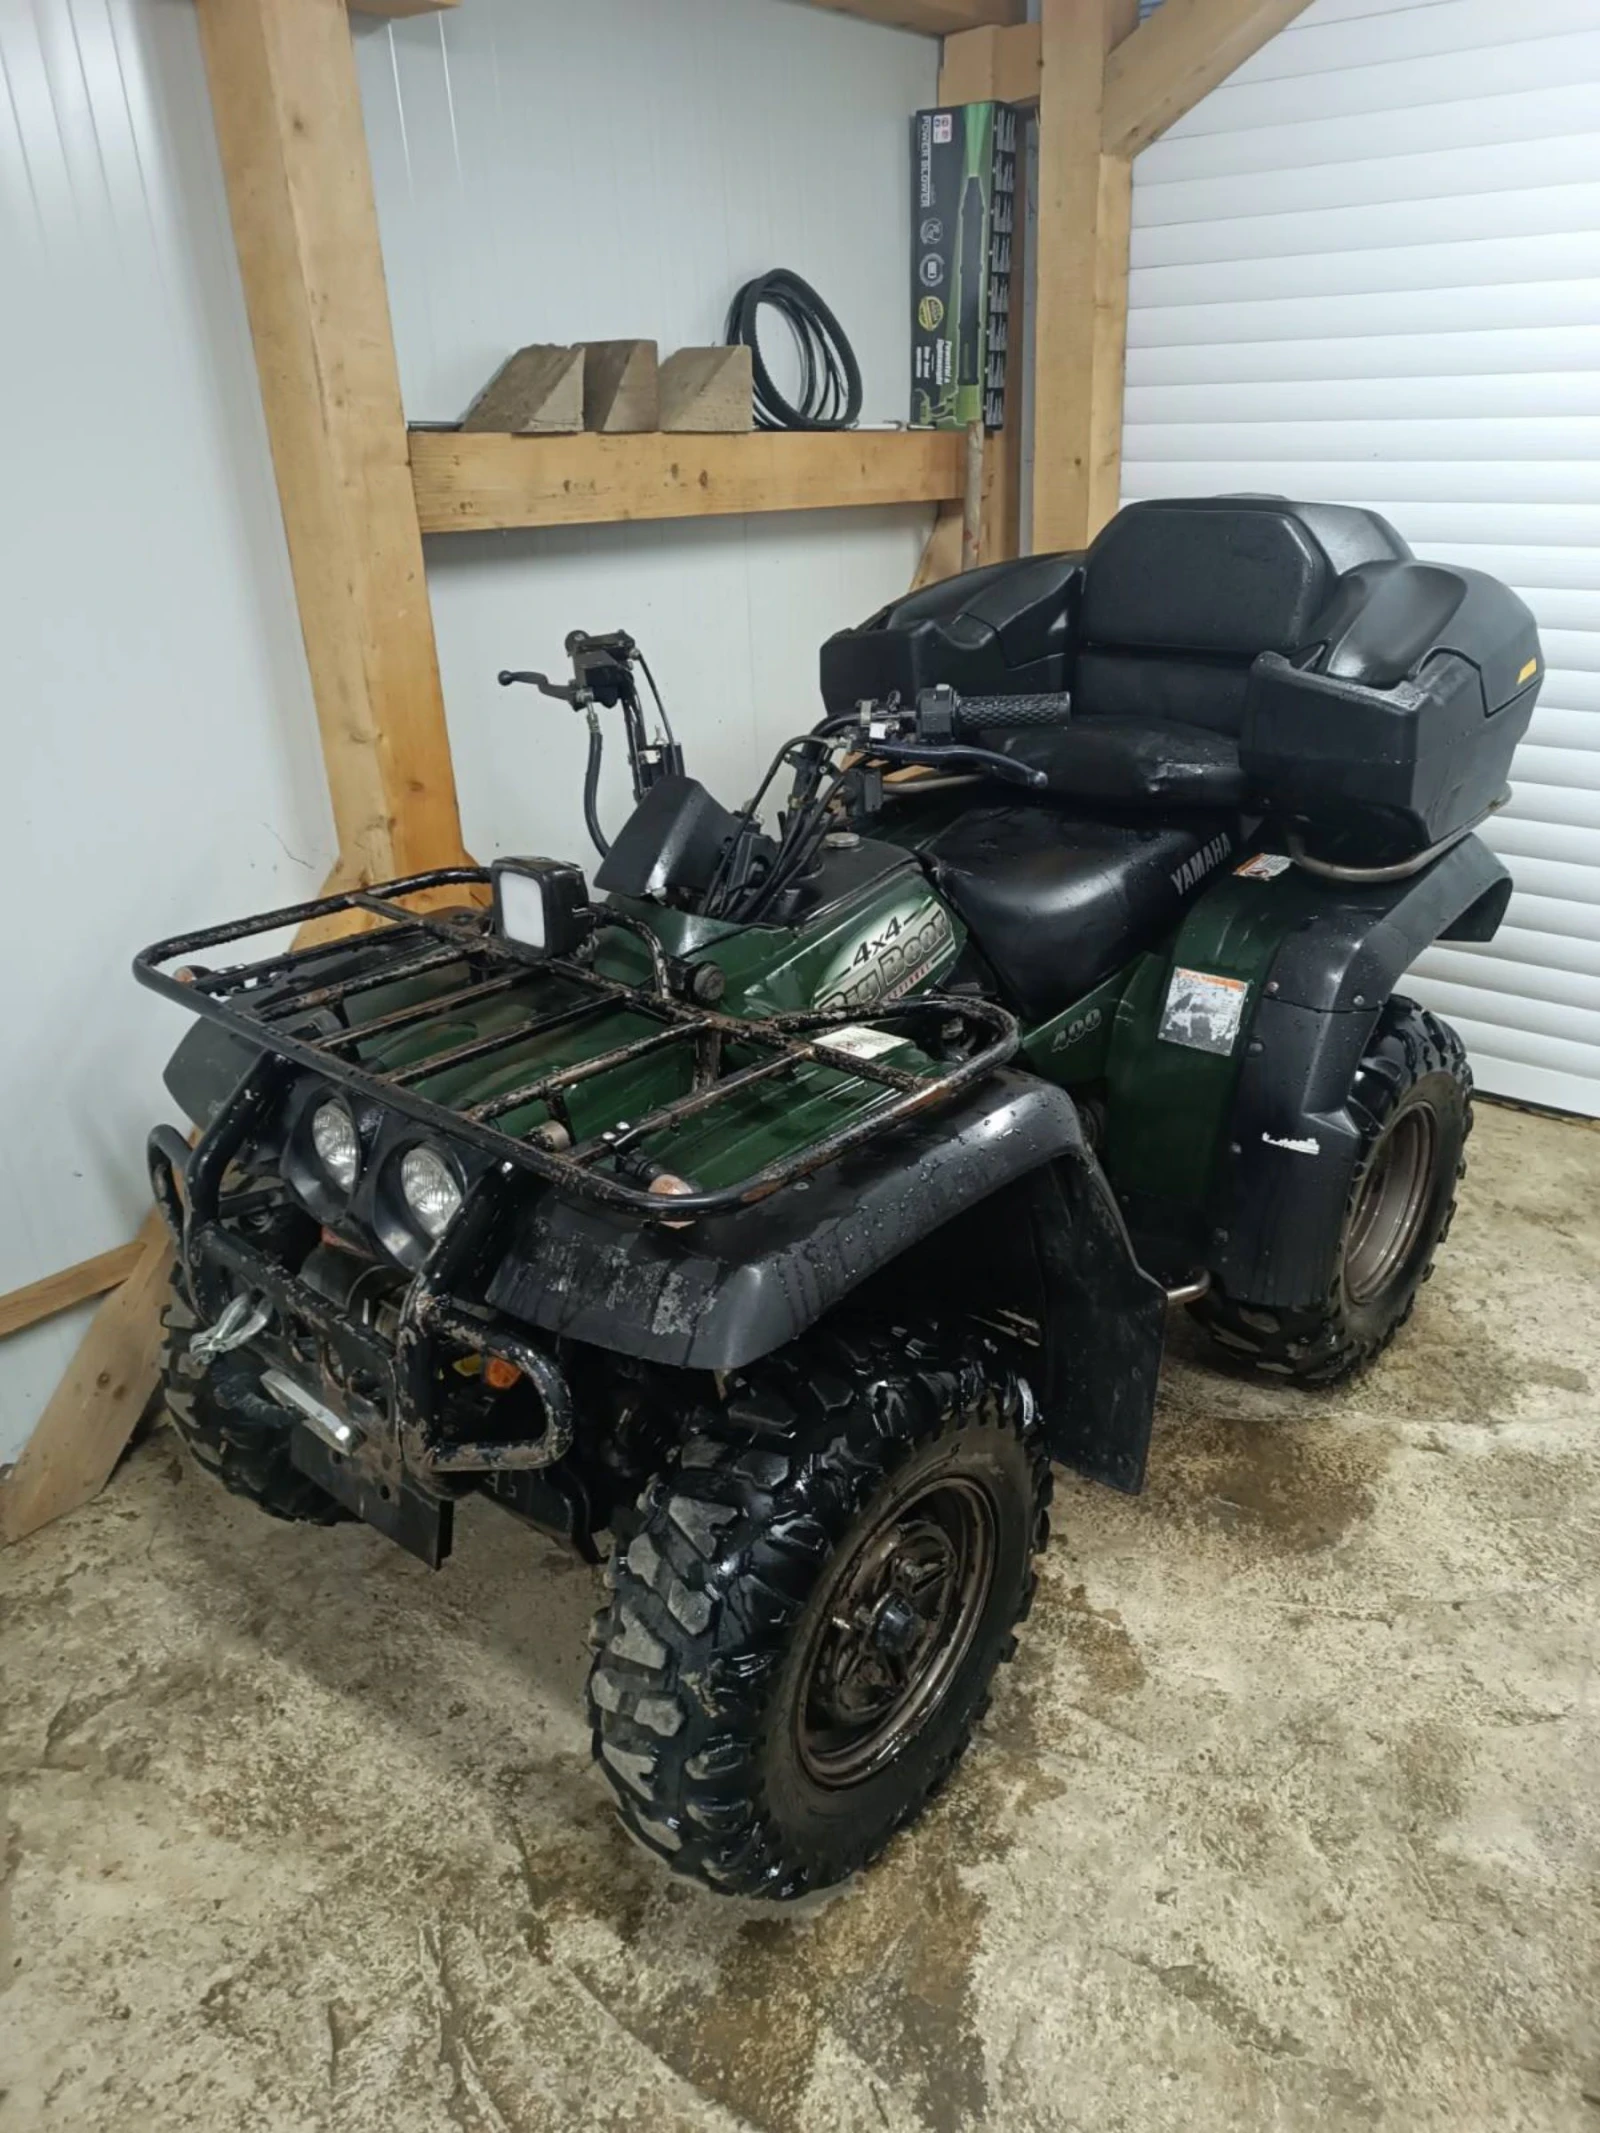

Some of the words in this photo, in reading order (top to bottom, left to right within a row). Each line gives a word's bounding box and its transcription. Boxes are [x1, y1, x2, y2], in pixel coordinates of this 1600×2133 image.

[920, 115, 932, 157] POWER
[920, 159, 931, 208] BLOWER
[1170, 832, 1232, 896] YAMAHA
[853, 916, 902, 967] 4x4
[878, 909, 947, 986] Bear
[1051, 1008, 1102, 1053] 400
